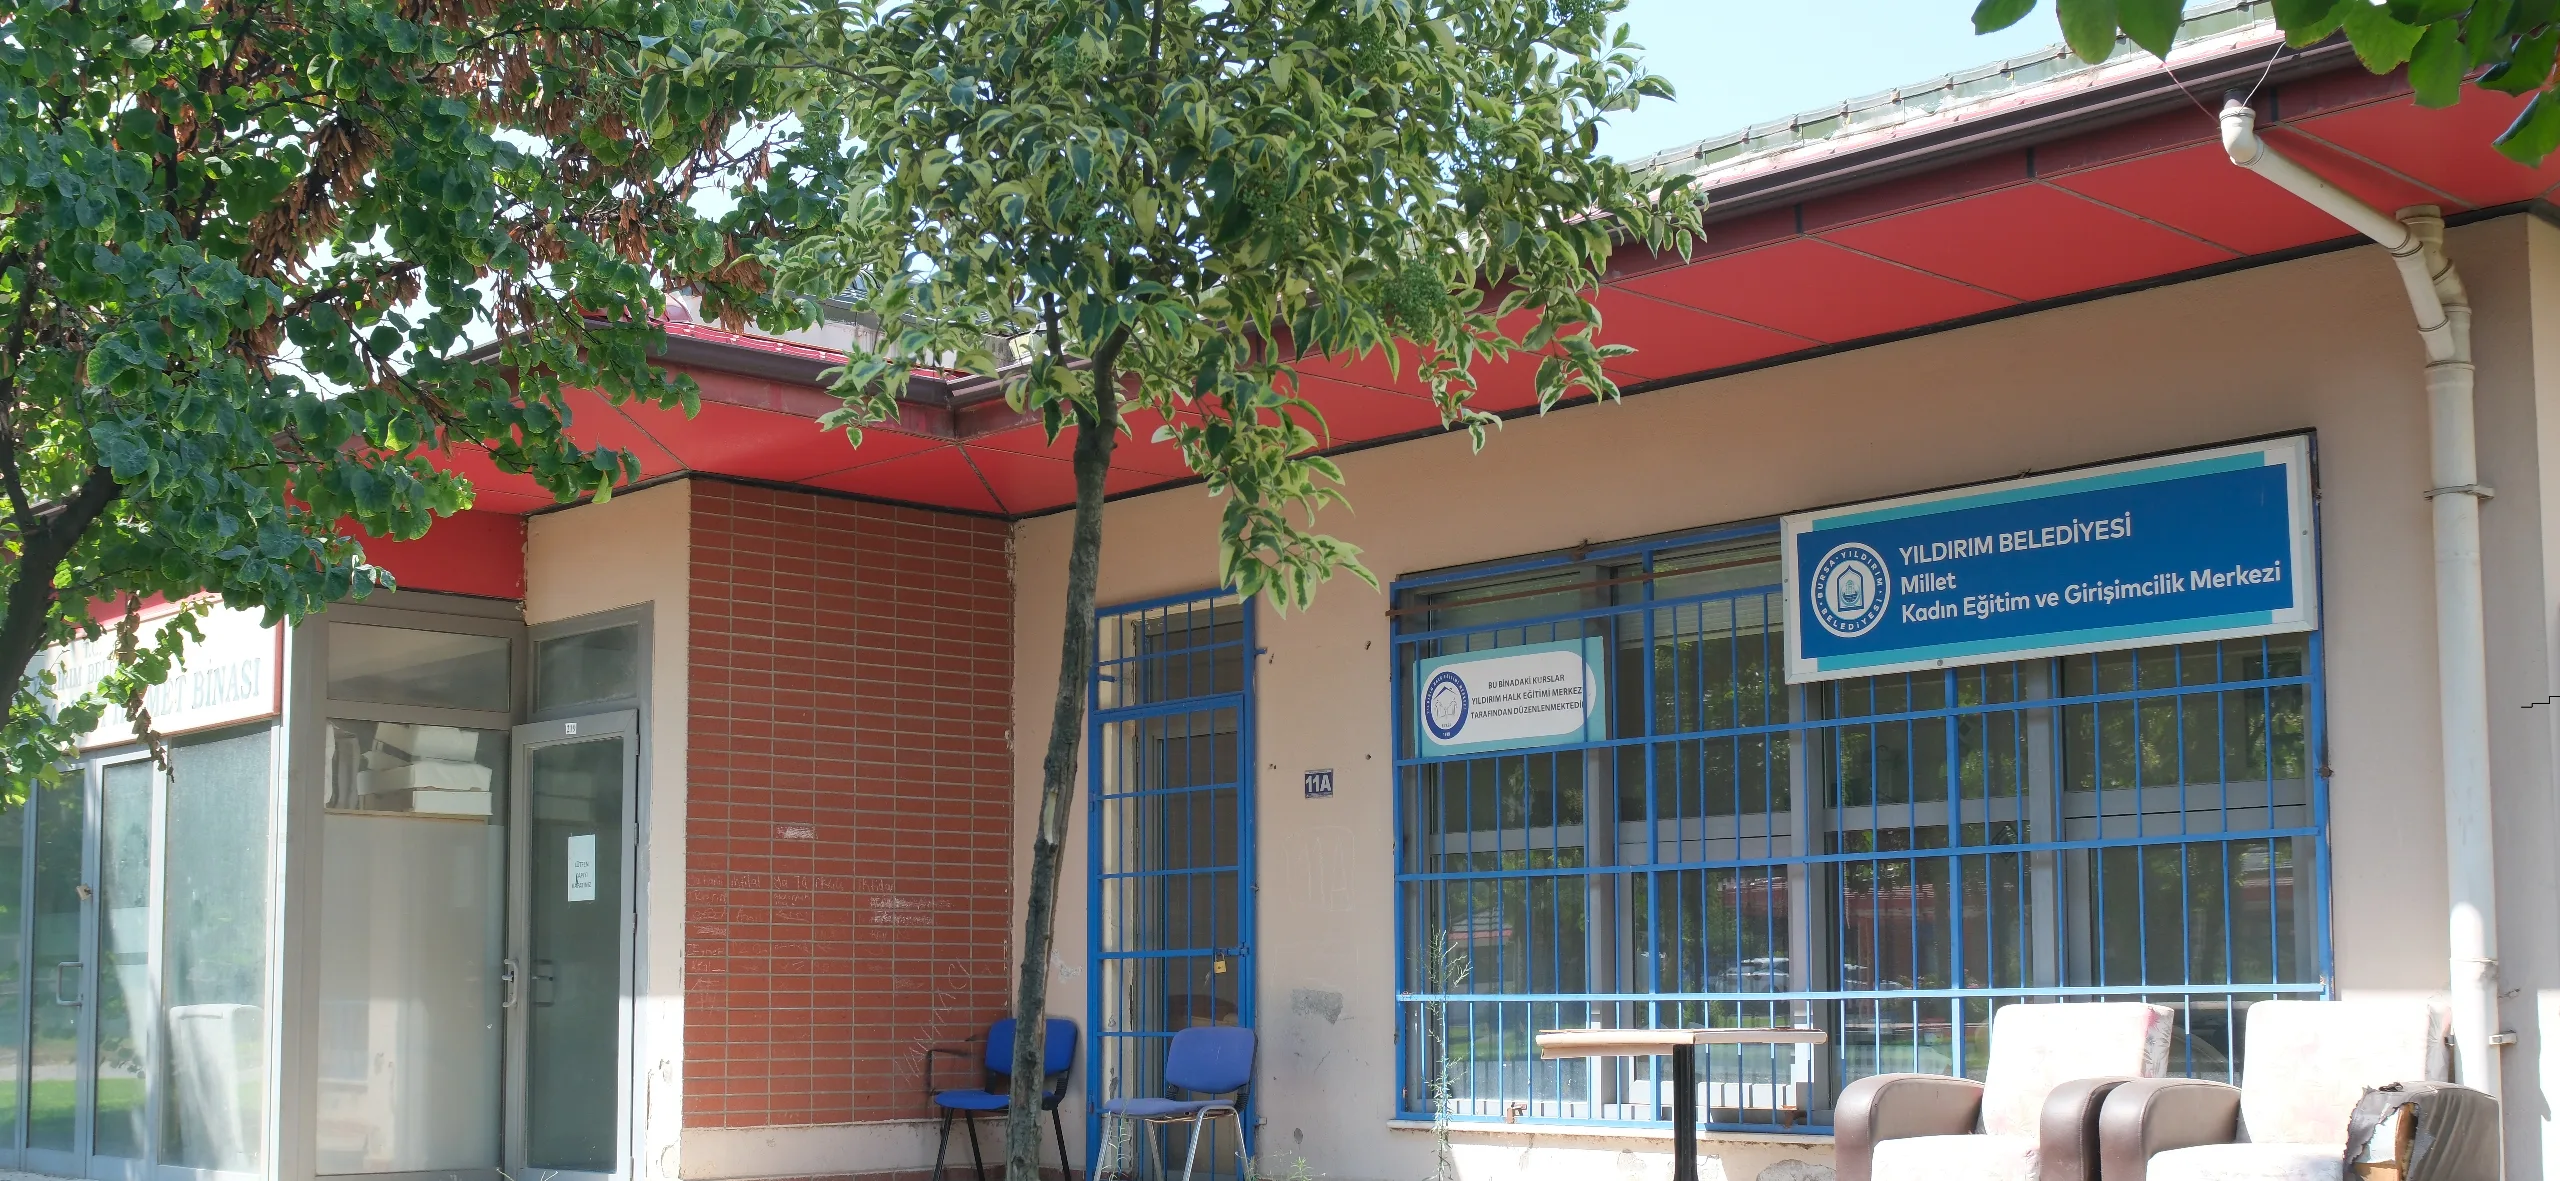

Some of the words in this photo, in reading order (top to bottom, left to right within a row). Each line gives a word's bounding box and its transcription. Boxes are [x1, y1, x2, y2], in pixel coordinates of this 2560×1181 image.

[1899, 535, 1993, 566] YILDIRIM
[1999, 511, 2131, 553] BELEDİYESİ
[1817, 559, 1836, 599] BURSA
[1840, 550, 1883, 586] YILDIRIM
[1901, 572, 1957, 595] Millet
[1902, 600, 1958, 624] Kadın
[1963, 591, 2030, 620] Eğitim
[2034, 592, 2059, 608] ve
[2064, 572, 2185, 605] Girişimcilik
[2190, 560, 2281, 591] Merkezi
[191, 657, 261, 710] BİNASI
[1471, 694, 1502, 706] YILDIRIM
[1502, 692, 1522, 703] HALK
[1523, 687, 1551, 700] EĞİTİMİ
[1551, 686, 1583, 698] MERKEZ
[1488, 681, 1498, 689] BU
[1498, 676, 1532, 688] BİNADAKİ
[1532, 674, 1565, 685] KURSLAR
[1470, 707, 1513, 720] TARAFINDAN
[1513, 700, 1584, 715] DÜZENLENMEKTEDİ
[1305, 774, 1332, 793] 11A
